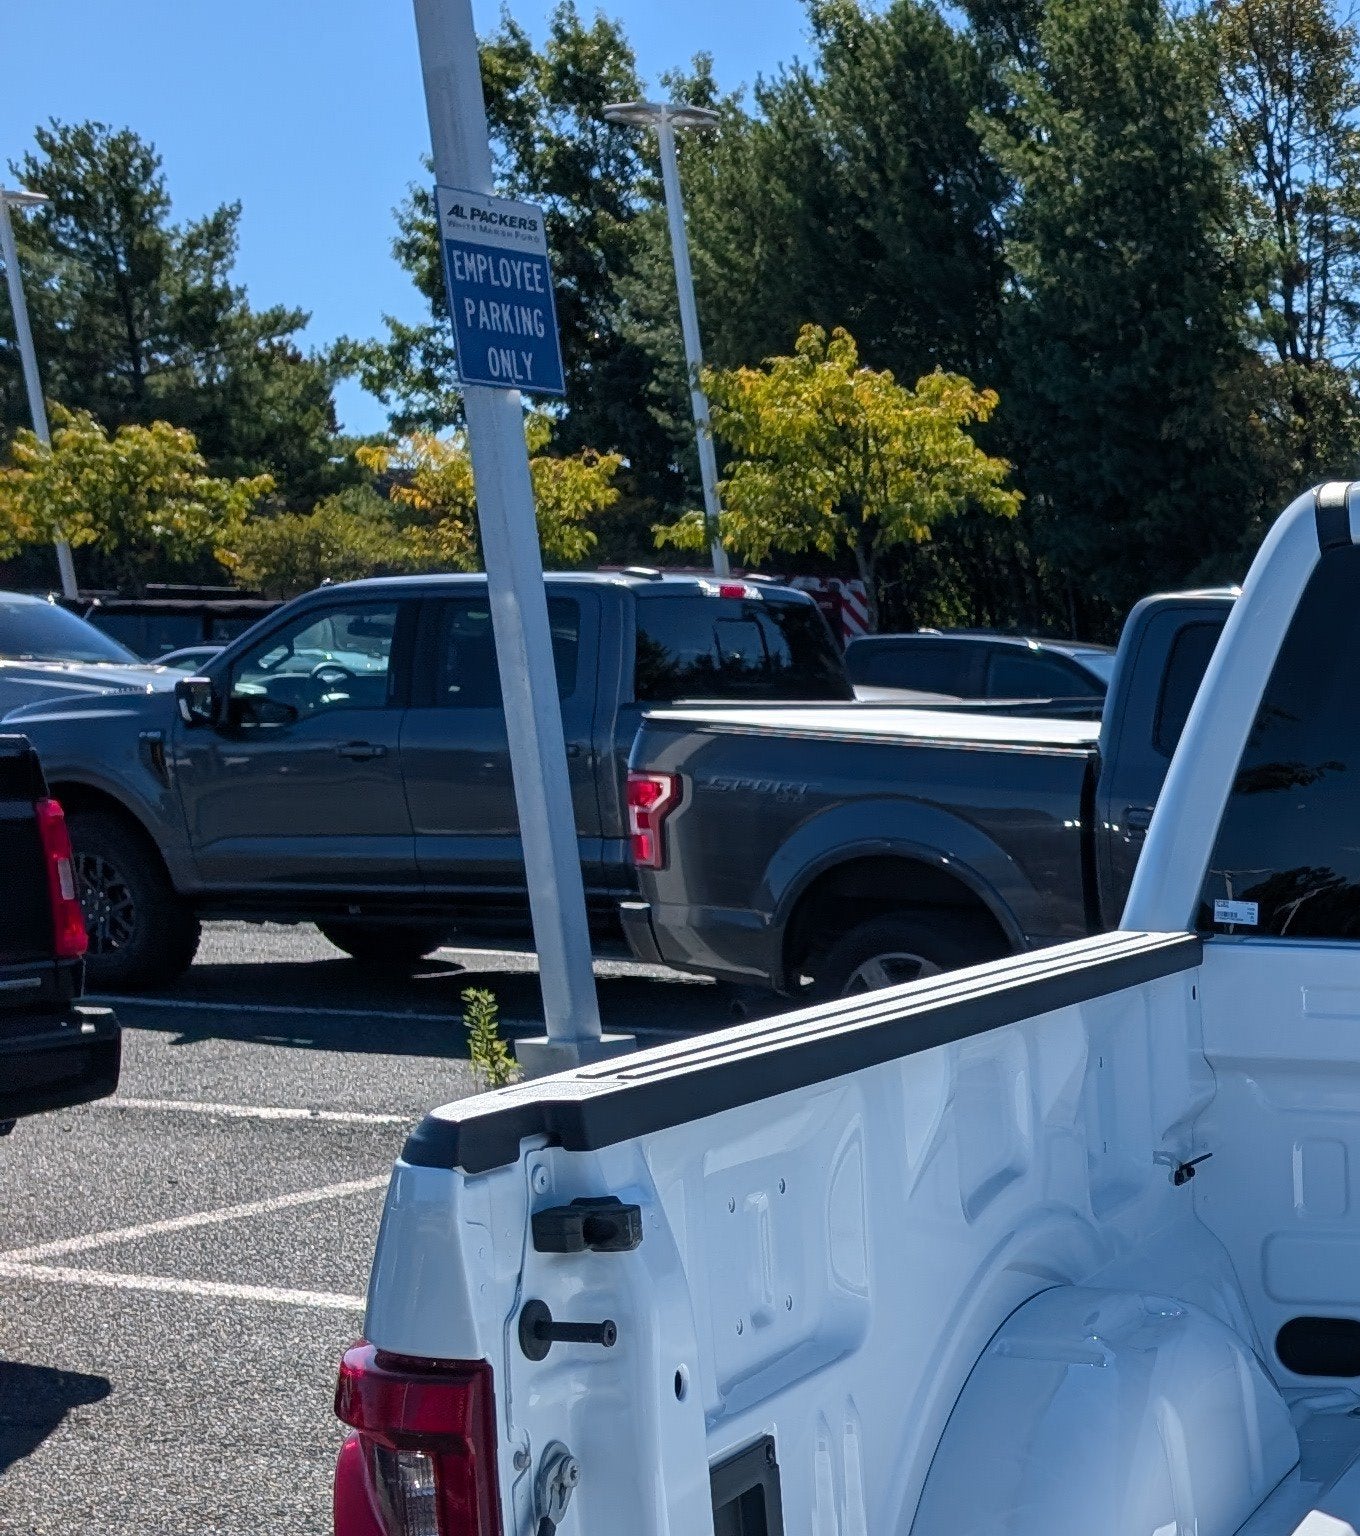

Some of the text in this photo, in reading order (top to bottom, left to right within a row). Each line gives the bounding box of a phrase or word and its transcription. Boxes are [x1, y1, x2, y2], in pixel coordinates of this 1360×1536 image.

[447, 203, 467, 220] AL
[452, 249, 545, 294] EMPLOYEE
[464, 297, 545, 338] PARKING
[487, 346, 533, 382] ONLY
